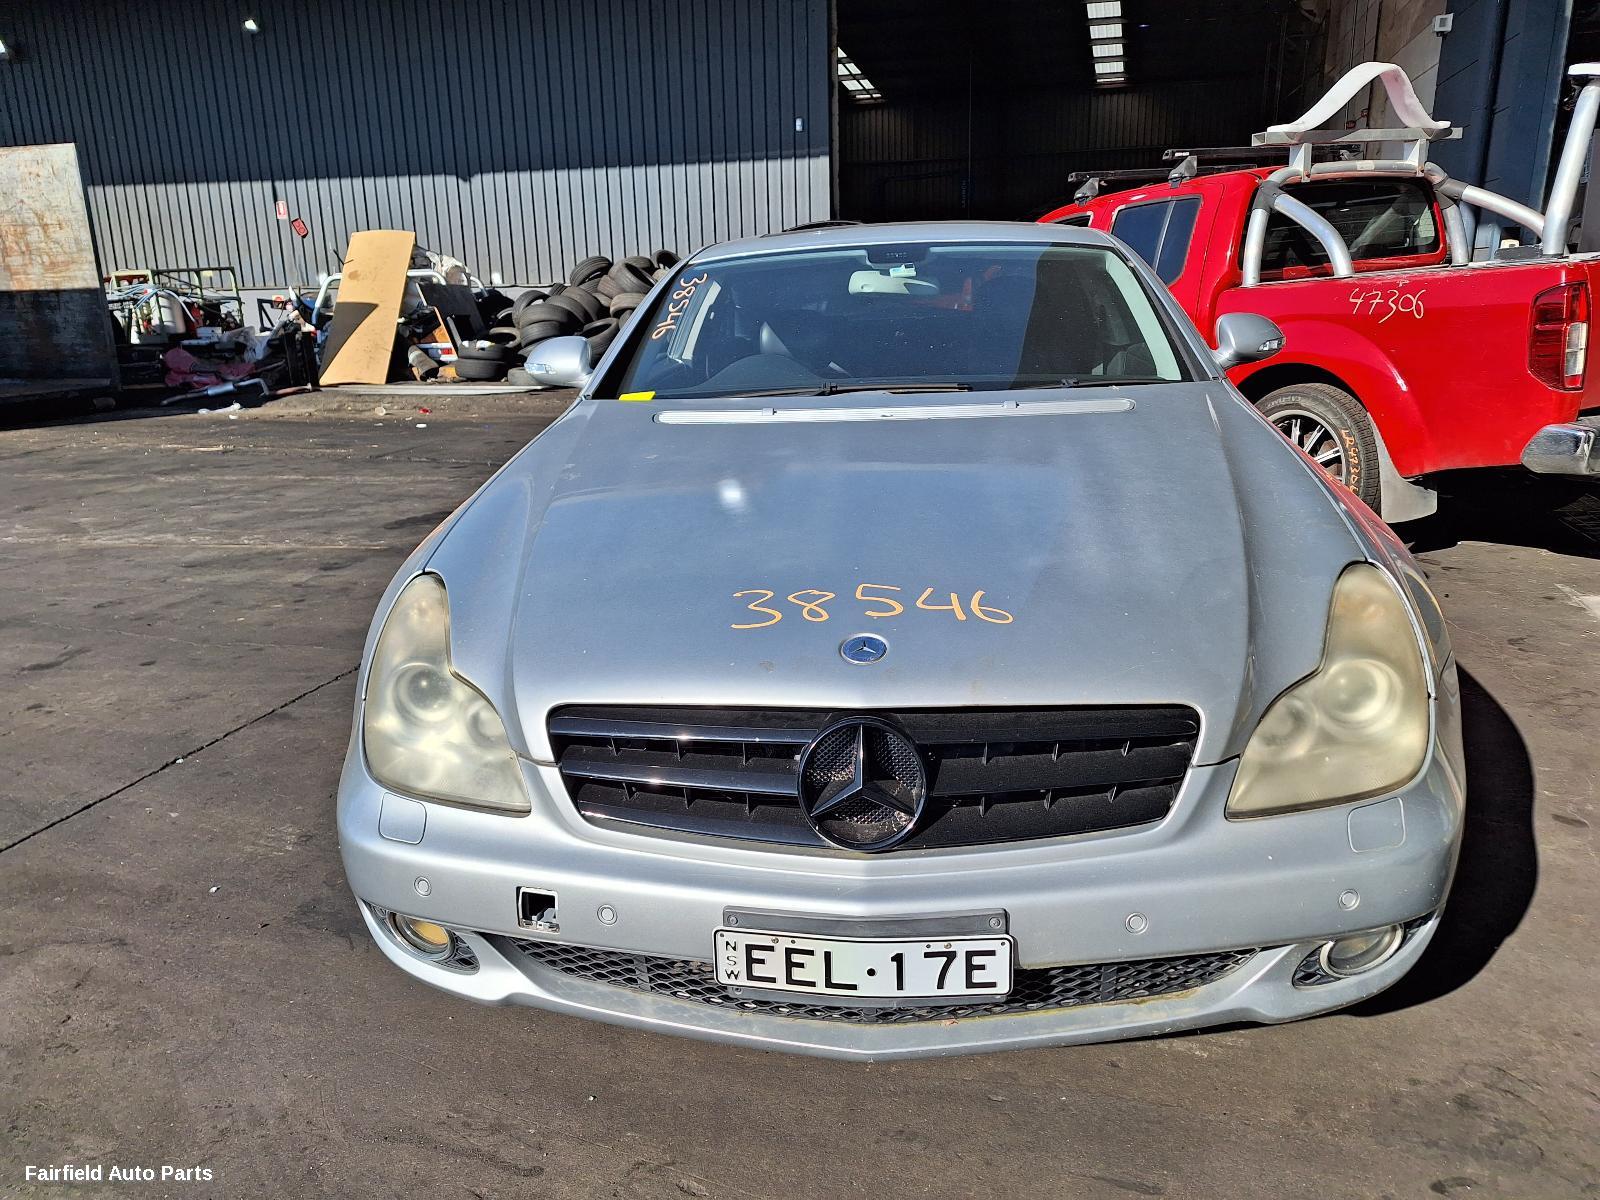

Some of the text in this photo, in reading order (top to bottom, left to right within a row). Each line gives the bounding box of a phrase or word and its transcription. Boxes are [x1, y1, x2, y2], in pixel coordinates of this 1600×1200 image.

[652, 272, 708, 340] 38546
[1349, 287, 1427, 324] 47306
[730, 583, 1014, 629] 38546
[724, 940, 740, 980] NSW
